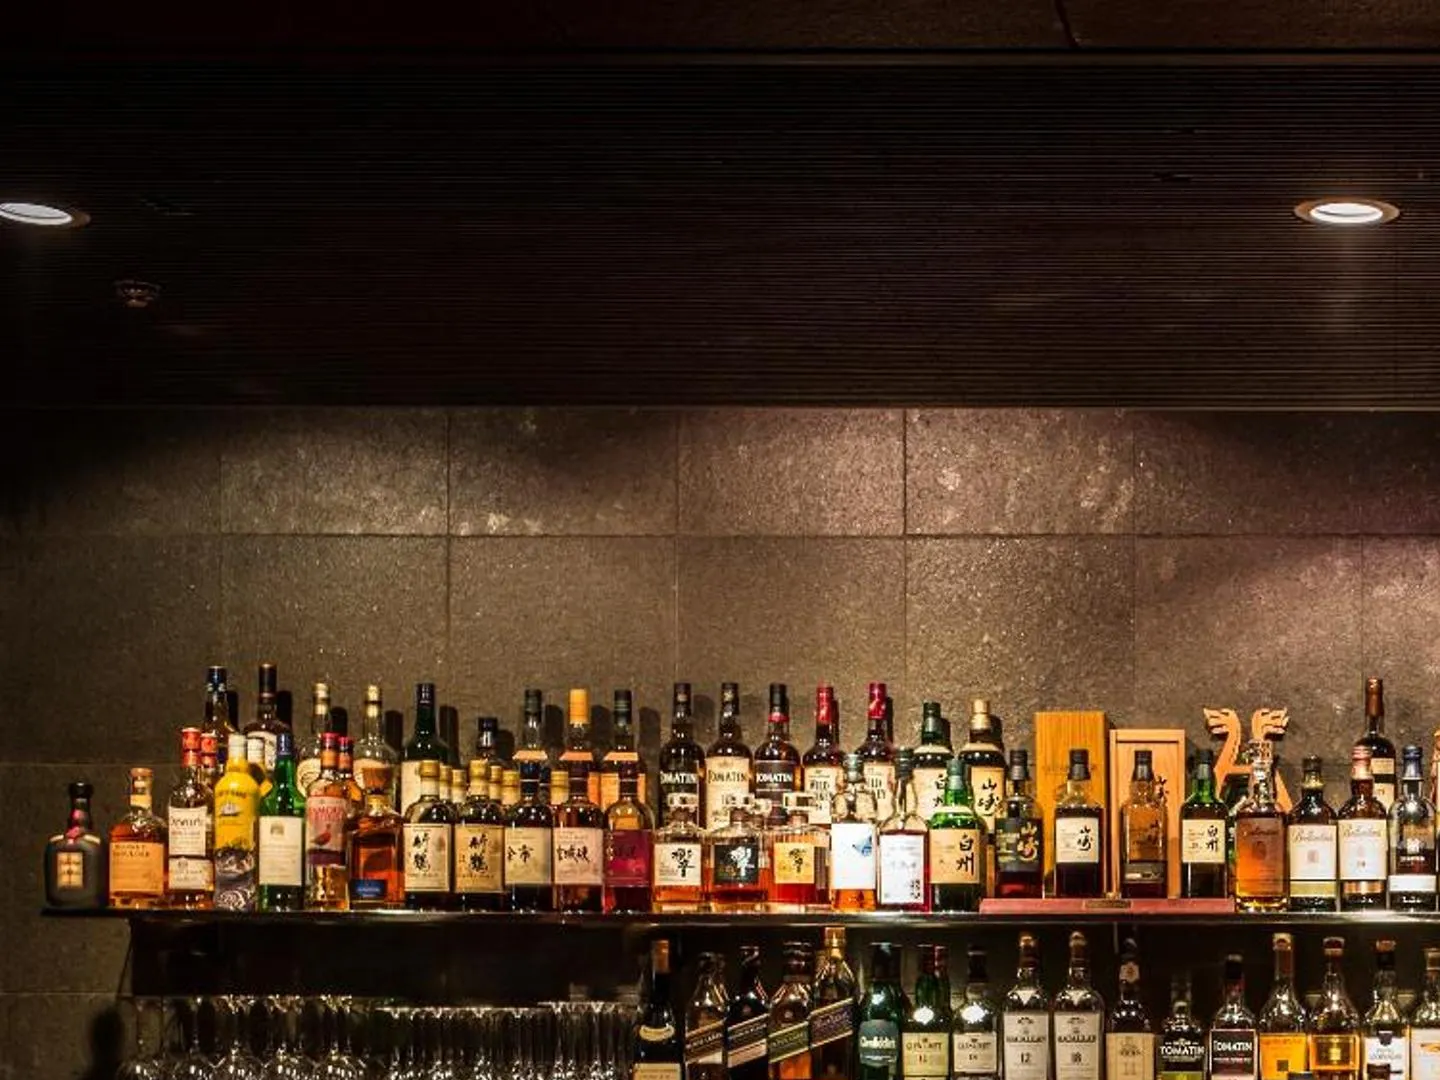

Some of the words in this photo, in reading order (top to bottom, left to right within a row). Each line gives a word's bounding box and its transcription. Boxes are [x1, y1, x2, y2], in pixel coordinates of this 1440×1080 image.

[956, 834, 975, 876] 白州
[1213, 1039, 1253, 1051] TOMATIN
[1160, 1045, 1205, 1058] TOMATIN
[1020, 1052, 1031, 1064] 12
